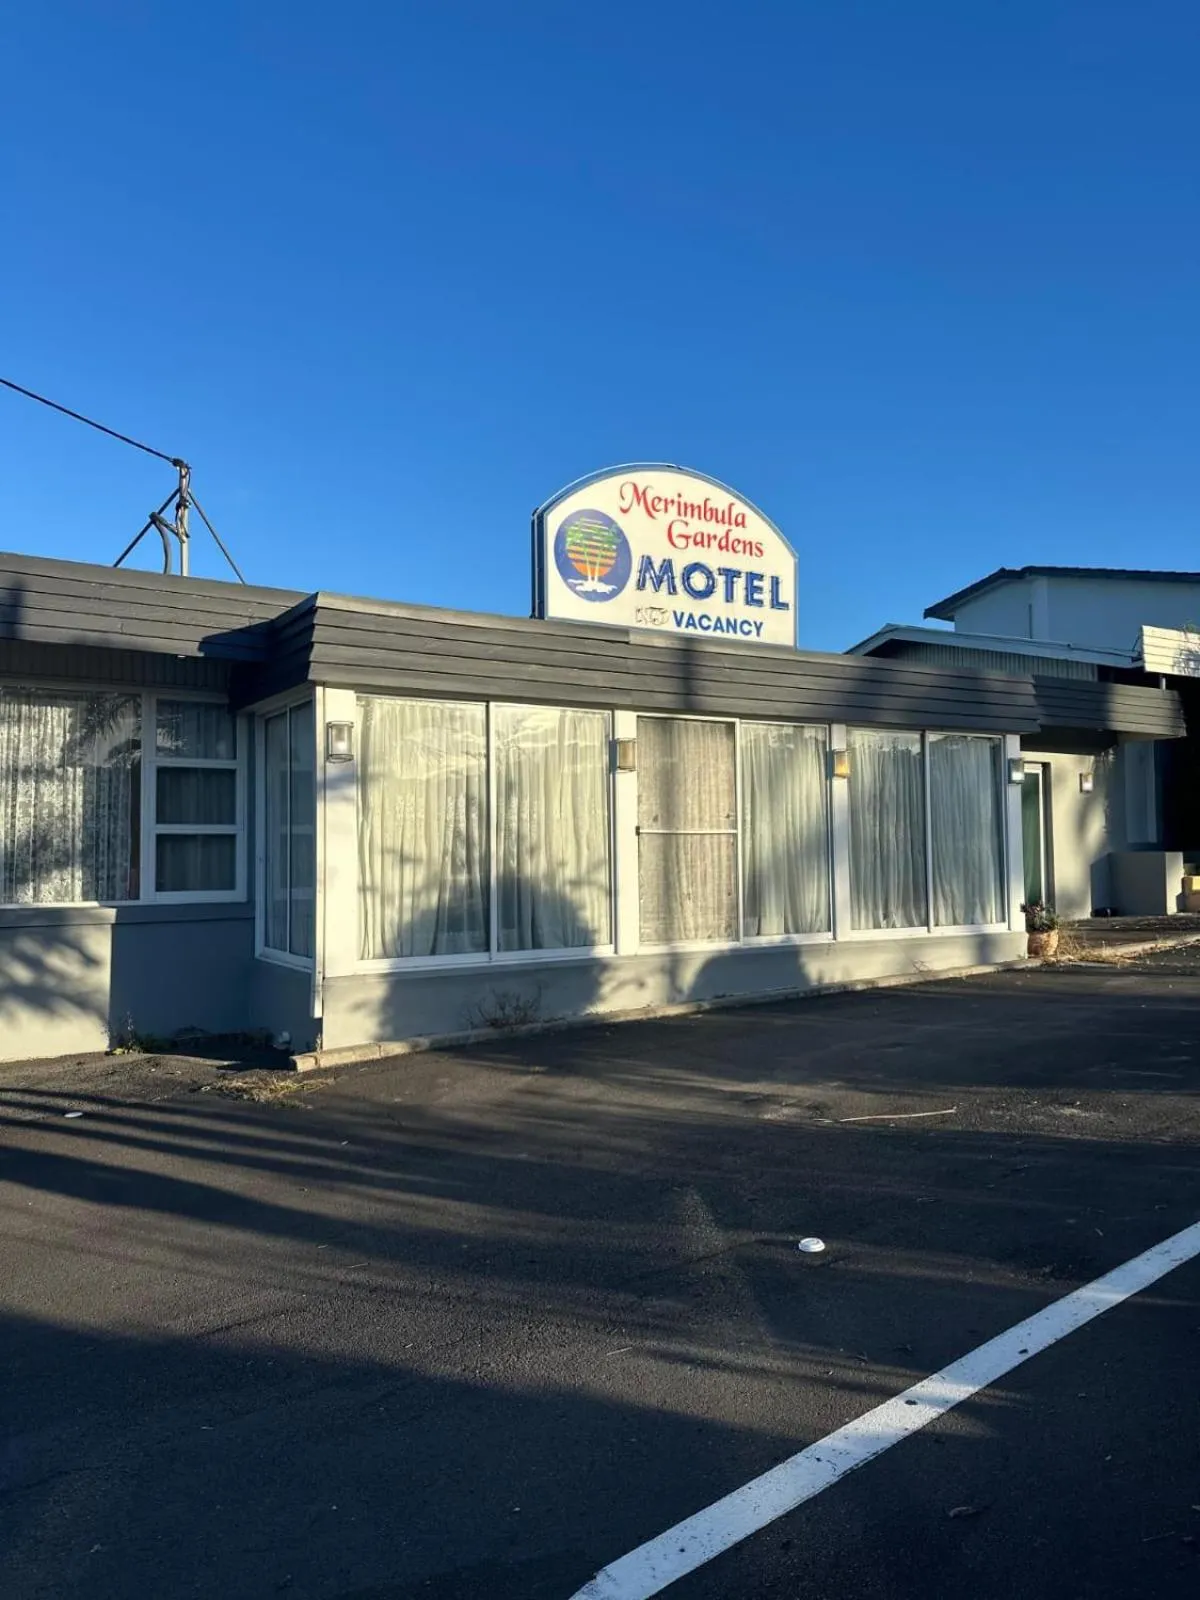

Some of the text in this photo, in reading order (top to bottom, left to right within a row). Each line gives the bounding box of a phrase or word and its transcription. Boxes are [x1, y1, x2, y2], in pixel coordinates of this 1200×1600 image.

[619, 481, 747, 529] Merimbula
[666, 519, 765, 558] Gardens
[636, 554, 790, 611] MOTEL
[672, 610, 764, 637] VACANCY
